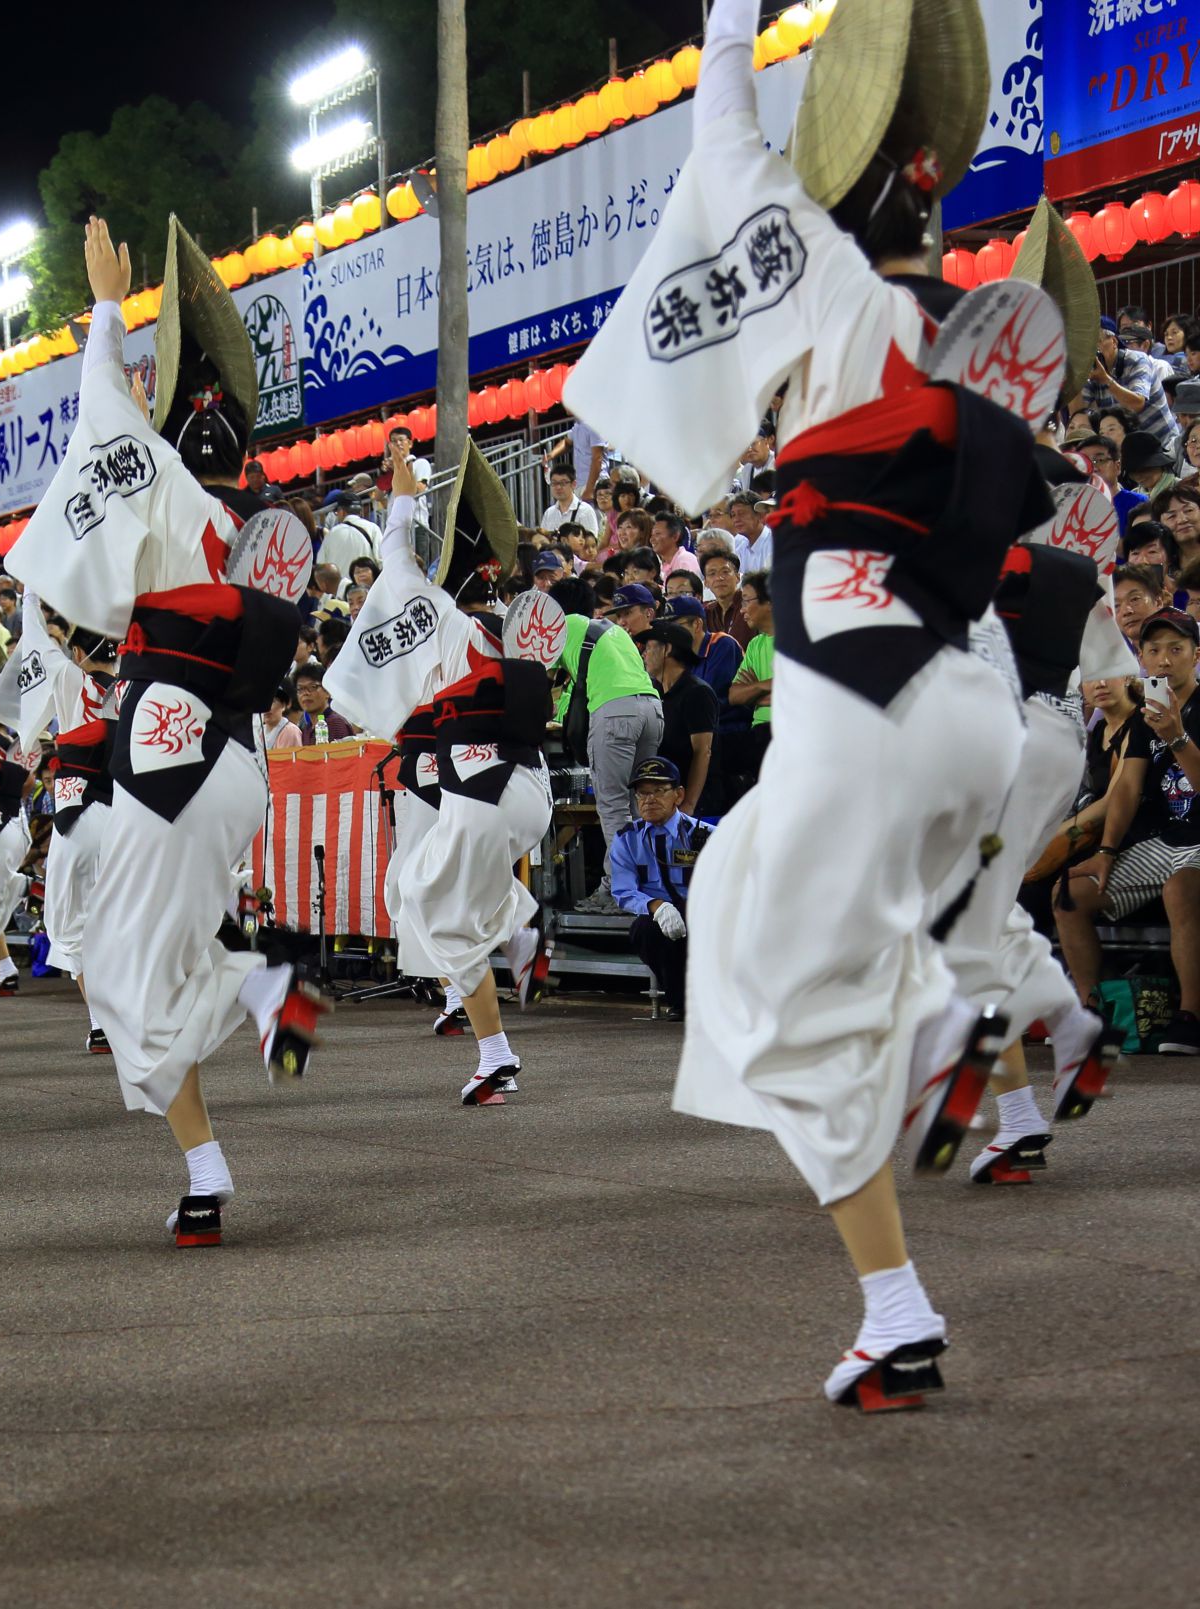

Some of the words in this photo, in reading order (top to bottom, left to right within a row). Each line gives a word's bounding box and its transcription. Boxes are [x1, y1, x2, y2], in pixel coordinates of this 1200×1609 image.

[1133, 16, 1188, 53] SUPER
[1158, 122, 1200, 160] 「アサ
[330, 247, 385, 288] SUNSTAR
